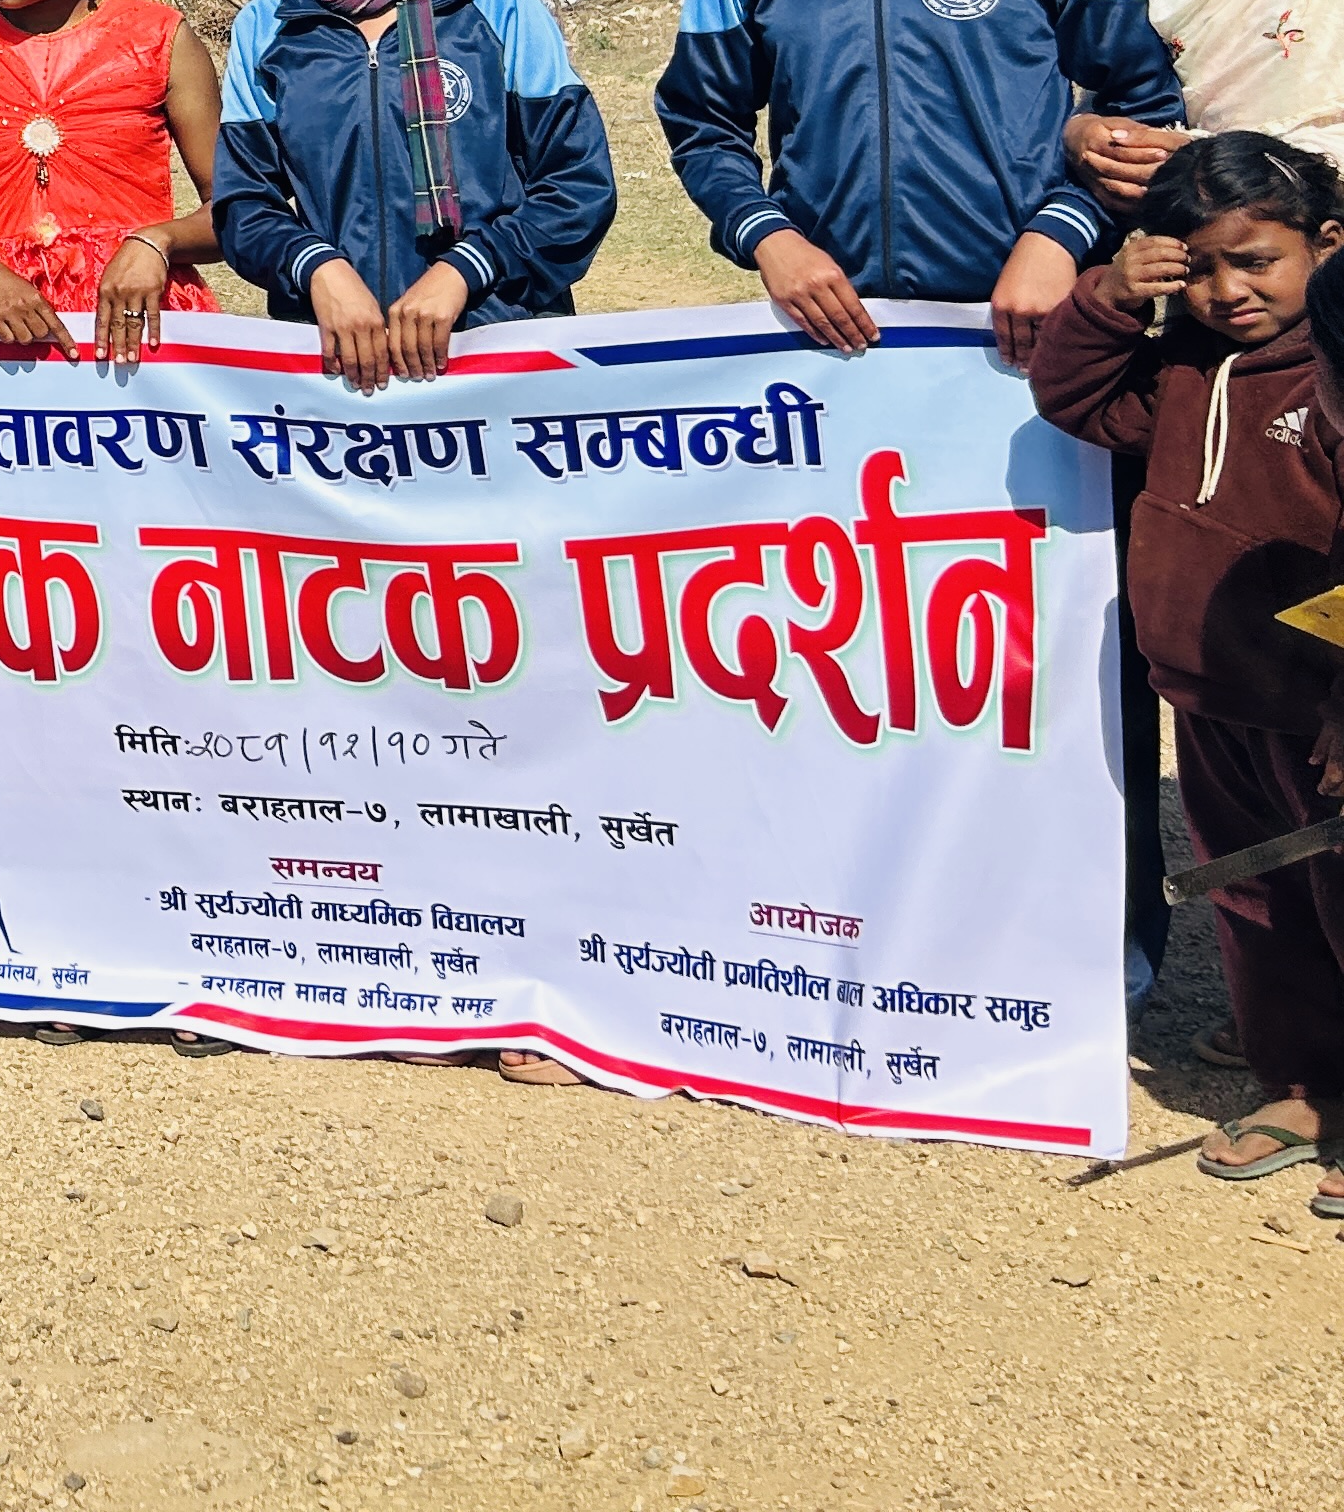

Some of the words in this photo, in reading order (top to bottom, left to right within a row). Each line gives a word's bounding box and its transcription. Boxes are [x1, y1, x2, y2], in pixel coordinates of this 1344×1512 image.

[230, 404, 489, 486] संरक्षण
[512, 381, 827, 480] सम्बन्धी
[138, 526, 520, 691] नाटक
[565, 449, 1048, 753] प्रदर्शन
[441, 719, 508, 761] गते
[598, 811, 679, 849] सुर्खेत
[268, 856, 383, 883] समन्वय
[159, 886, 187, 912] श्री
[310, 898, 422, 928] माध्यमिक
[430, 902, 526, 938] विद्यालय
[748, 902, 863, 940] आयोजक
[51, 963, 91, 989] सुर्खेत
[430, 946, 480, 980] सुर्खेत
[578, 933, 607, 964] श्री
[723, 958, 831, 1002] प्रगतिशील
[871, 981, 978, 1020] अधिकार
[200, 974, 286, 1002] बराहताल
[294, 982, 347, 1007] मानव
[357, 982, 442, 1016] अधिकार
[884, 1046, 941, 1085] सुर्खेत
